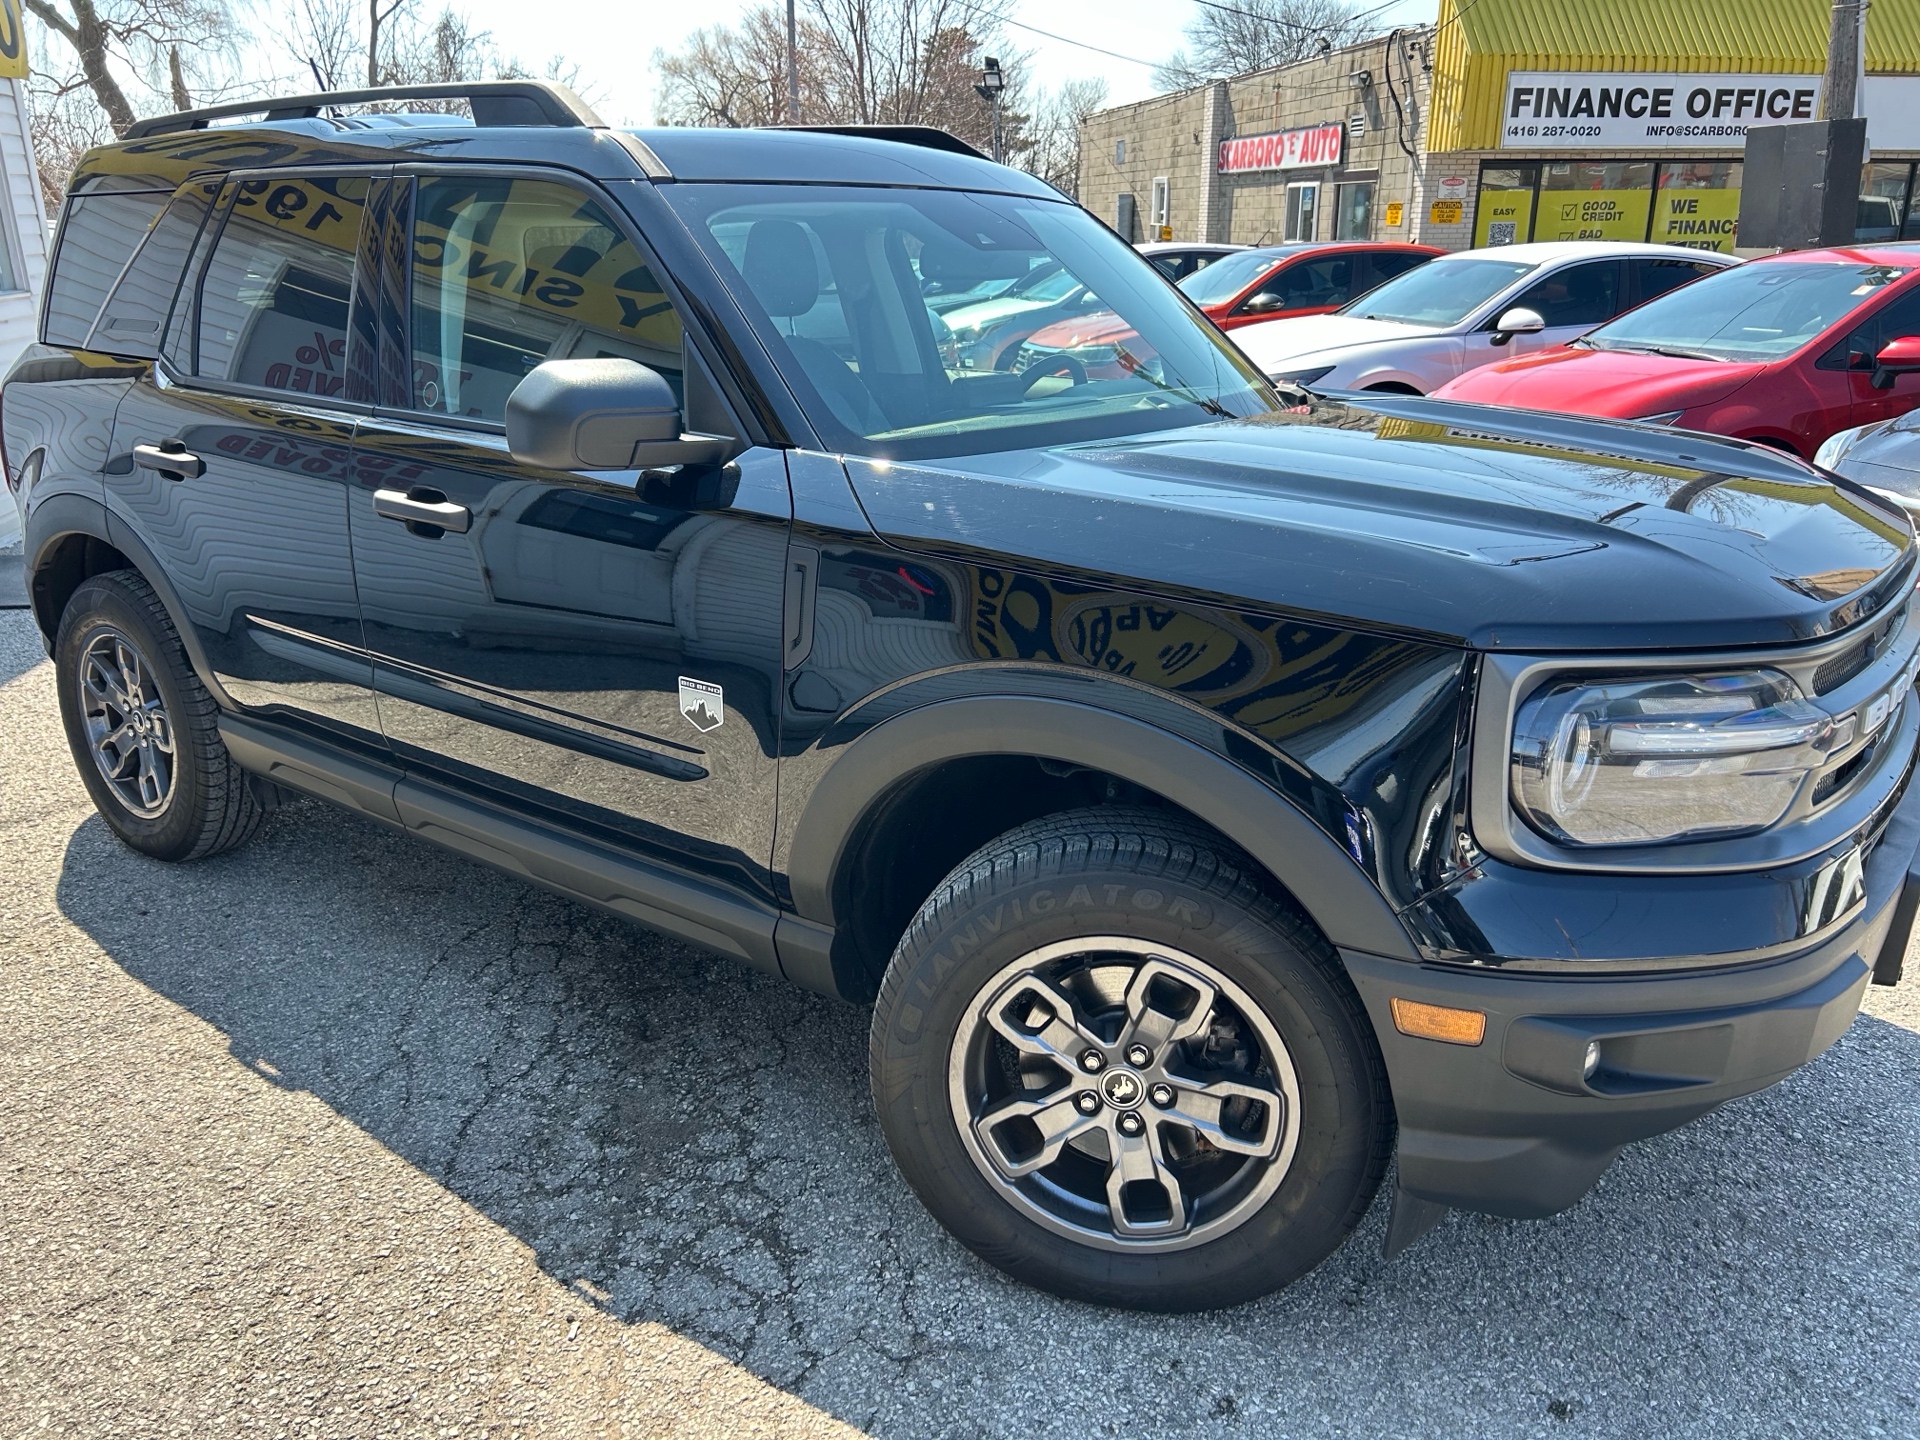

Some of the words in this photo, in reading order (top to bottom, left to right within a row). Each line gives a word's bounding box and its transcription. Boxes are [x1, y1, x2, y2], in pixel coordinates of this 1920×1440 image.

[1510, 87, 1674, 118] FINANCE
[1686, 87, 1815, 119] OFFICE
[1507, 125, 1538, 137] (416)
[1541, 126, 1601, 136] 287-0020
[1218, 134, 1285, 171] SCARBORO
[1298, 125, 1340, 163] AUTO
[1493, 208, 1516, 216] EASY
[1582, 201, 1616, 211] GOOD
[1671, 199, 1699, 214] WE
[1581, 211, 1624, 221] CREDIT
[1667, 219, 1737, 235] FINANC
[1578, 230, 1603, 239] BAD
[1665, 240, 1723, 252] ERY
[681, 680, 695, 688] BIG
[696, 684, 720, 694] BEND
[915, 884, 1202, 998] LANVIGATOR
